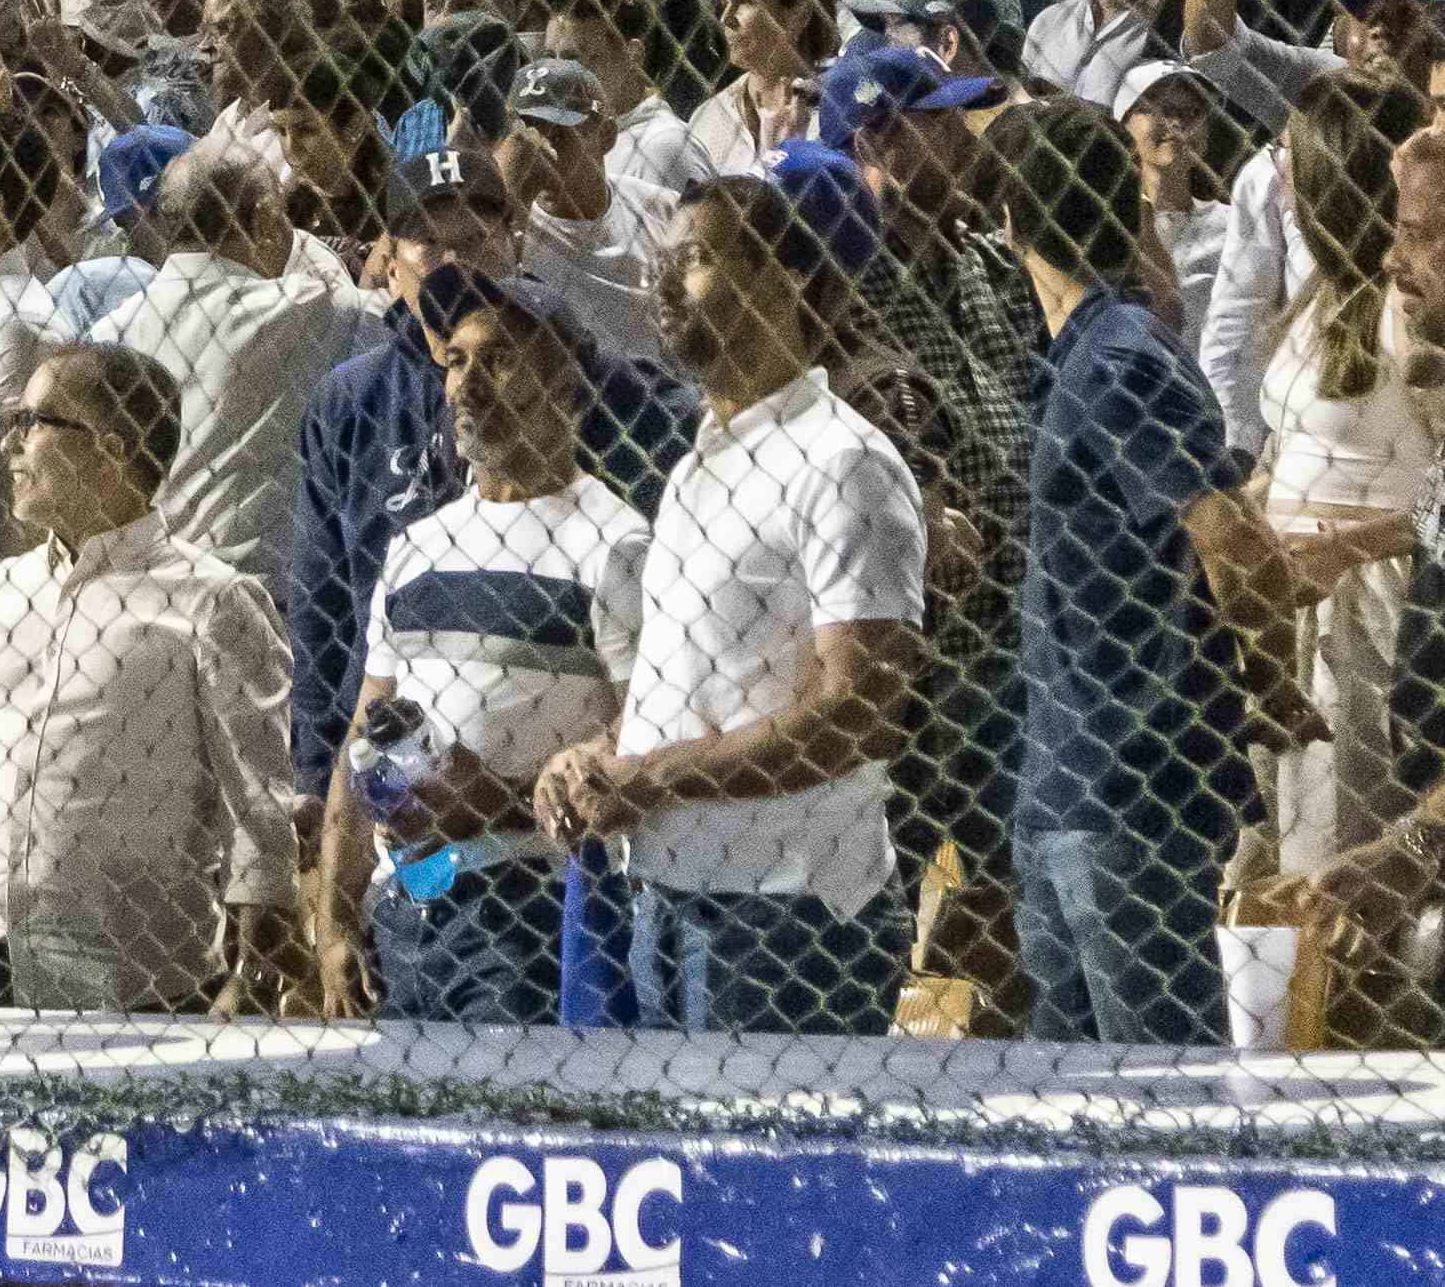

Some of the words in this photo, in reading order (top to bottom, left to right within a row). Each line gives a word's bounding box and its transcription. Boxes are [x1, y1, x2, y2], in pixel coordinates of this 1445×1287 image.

[519, 66, 550, 97] L
[425, 150, 465, 187] H
[465, 1156, 683, 1275] GBC
[21, 1240, 113, 1261] FARMACIAS
[1082, 1184, 1338, 1287] GBC
